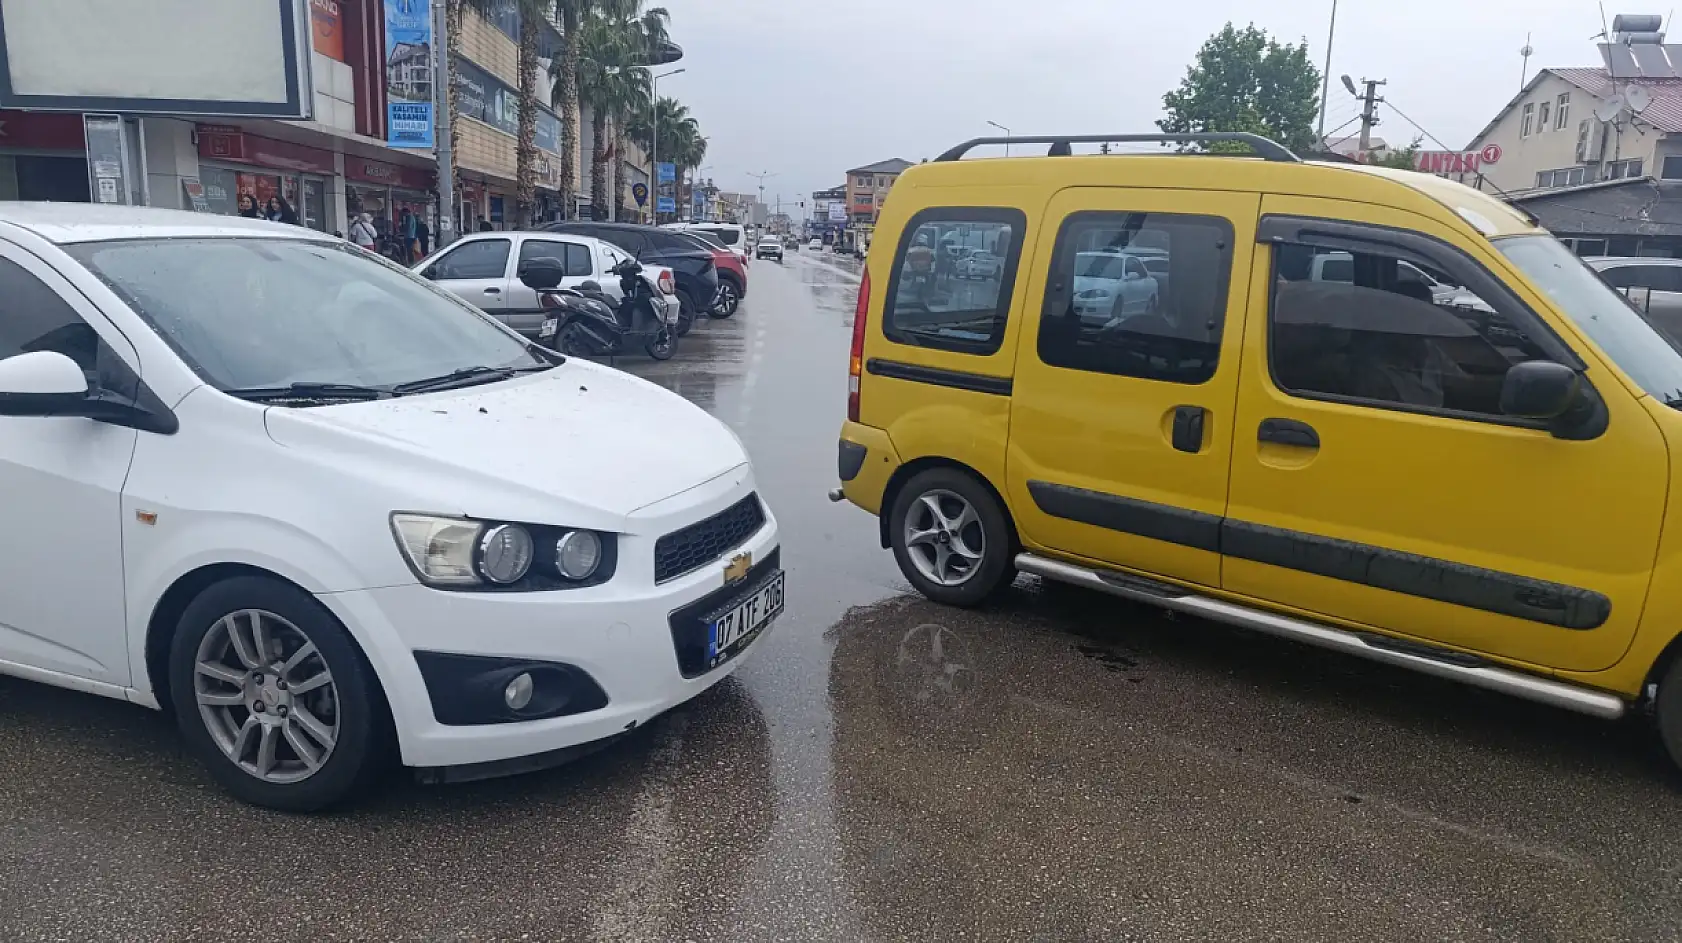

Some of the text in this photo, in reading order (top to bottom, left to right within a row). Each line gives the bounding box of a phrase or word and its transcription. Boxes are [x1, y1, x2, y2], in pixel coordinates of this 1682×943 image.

[717, 612, 734, 650] 07
[737, 596, 759, 636] ATF
[764, 579, 781, 616] 206
